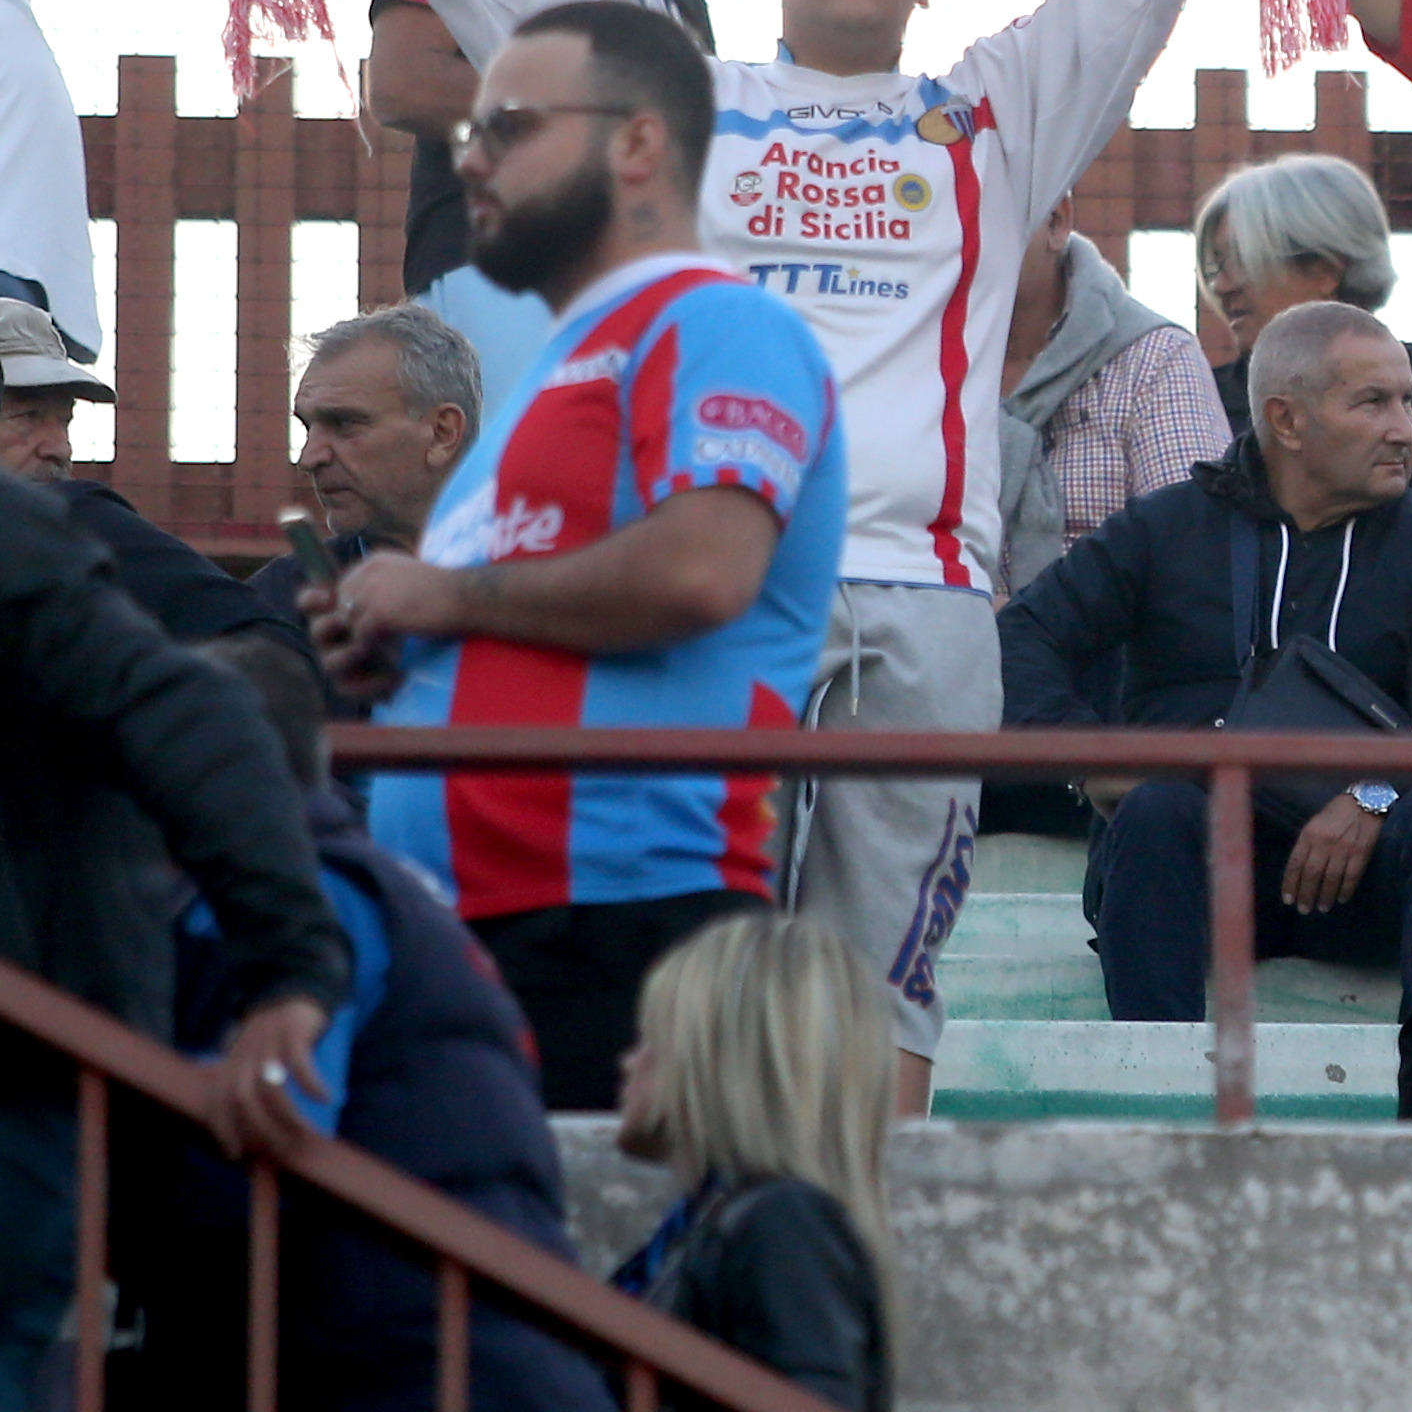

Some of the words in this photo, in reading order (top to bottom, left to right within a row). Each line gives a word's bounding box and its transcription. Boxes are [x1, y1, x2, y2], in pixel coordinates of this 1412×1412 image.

[787, 101, 893, 119] GIVOA
[761, 142, 900, 179] Arancia
[777, 171, 886, 208] Rossa
[748, 204, 784, 237] di
[800, 210, 911, 241] Sicilia
